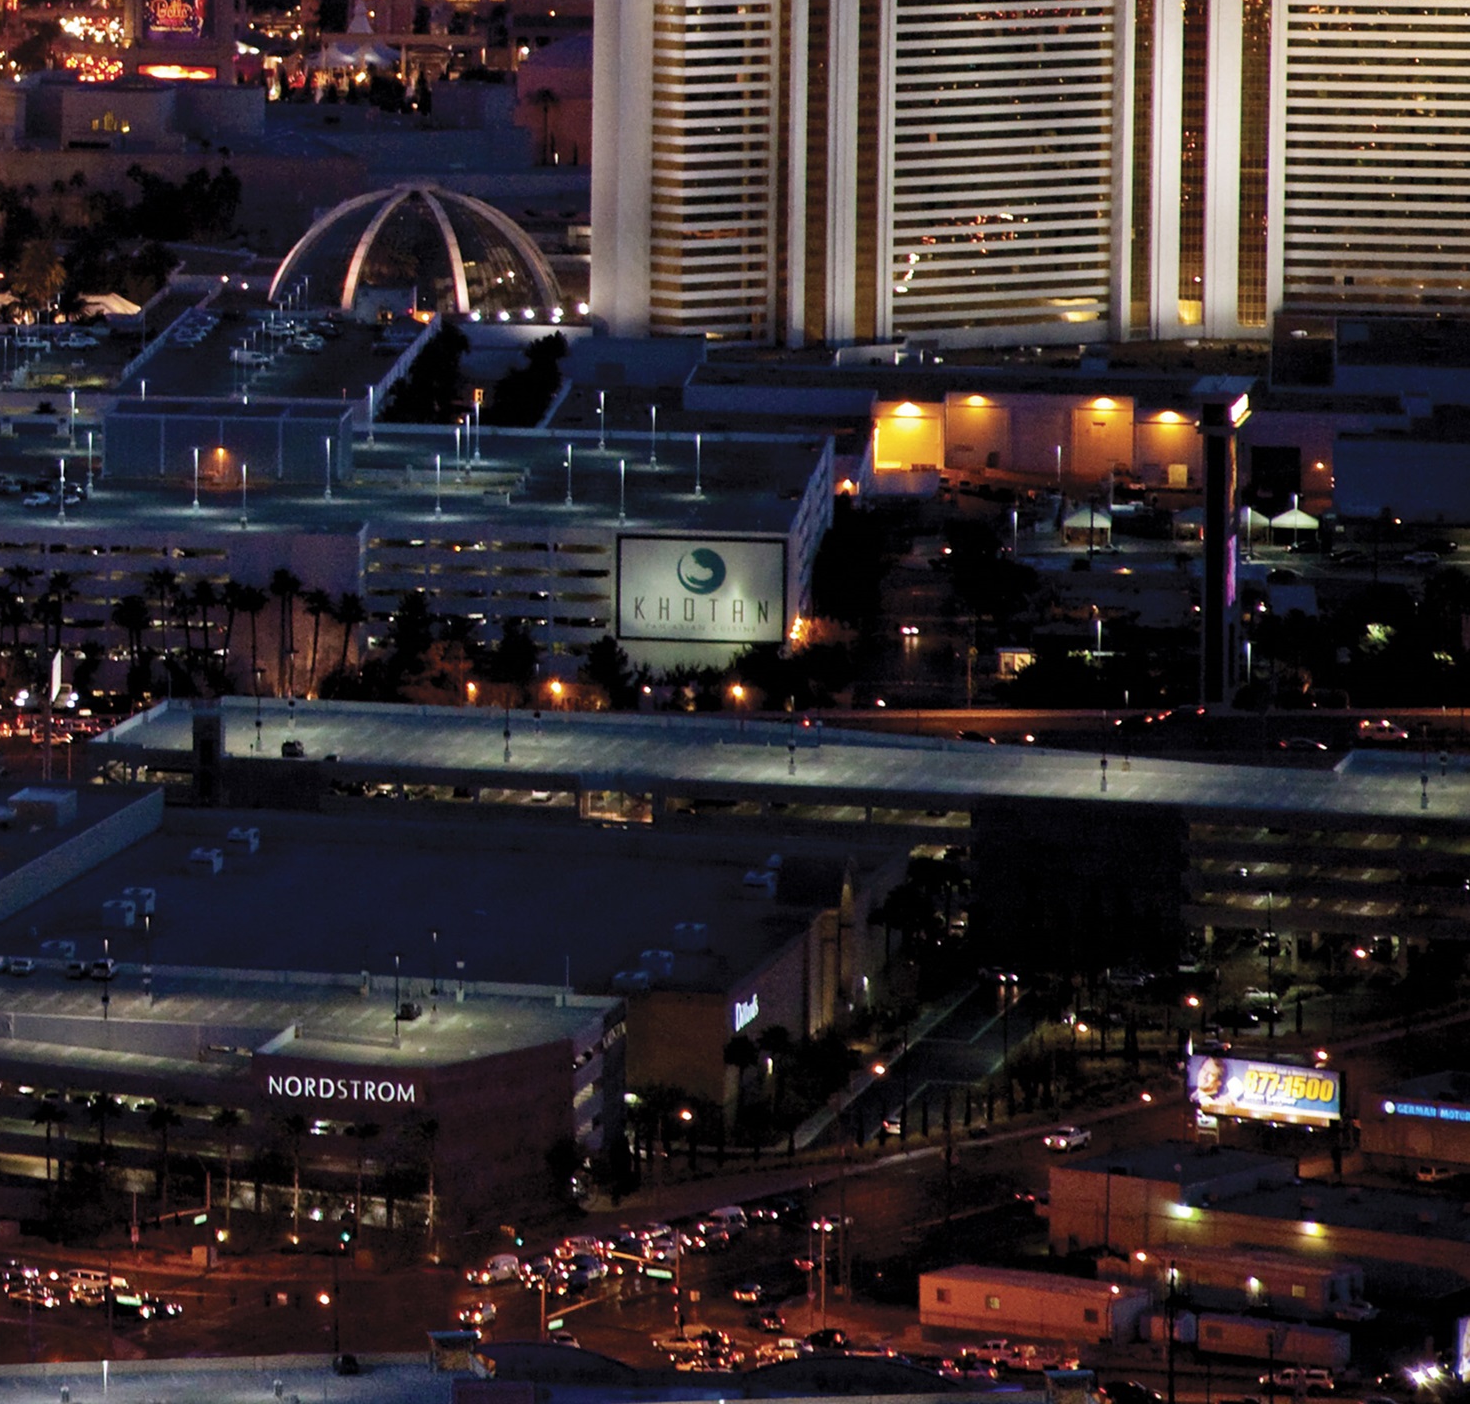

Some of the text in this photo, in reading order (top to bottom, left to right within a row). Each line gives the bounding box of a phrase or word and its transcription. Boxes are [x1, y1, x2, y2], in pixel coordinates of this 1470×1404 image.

[634, 596, 770, 623] KHOTAN
[268, 1075, 415, 1103] NORDSTROM
[1244, 1070, 1334, 1102] 877-1500
[1396, 1104, 1437, 1117] GERMAN
